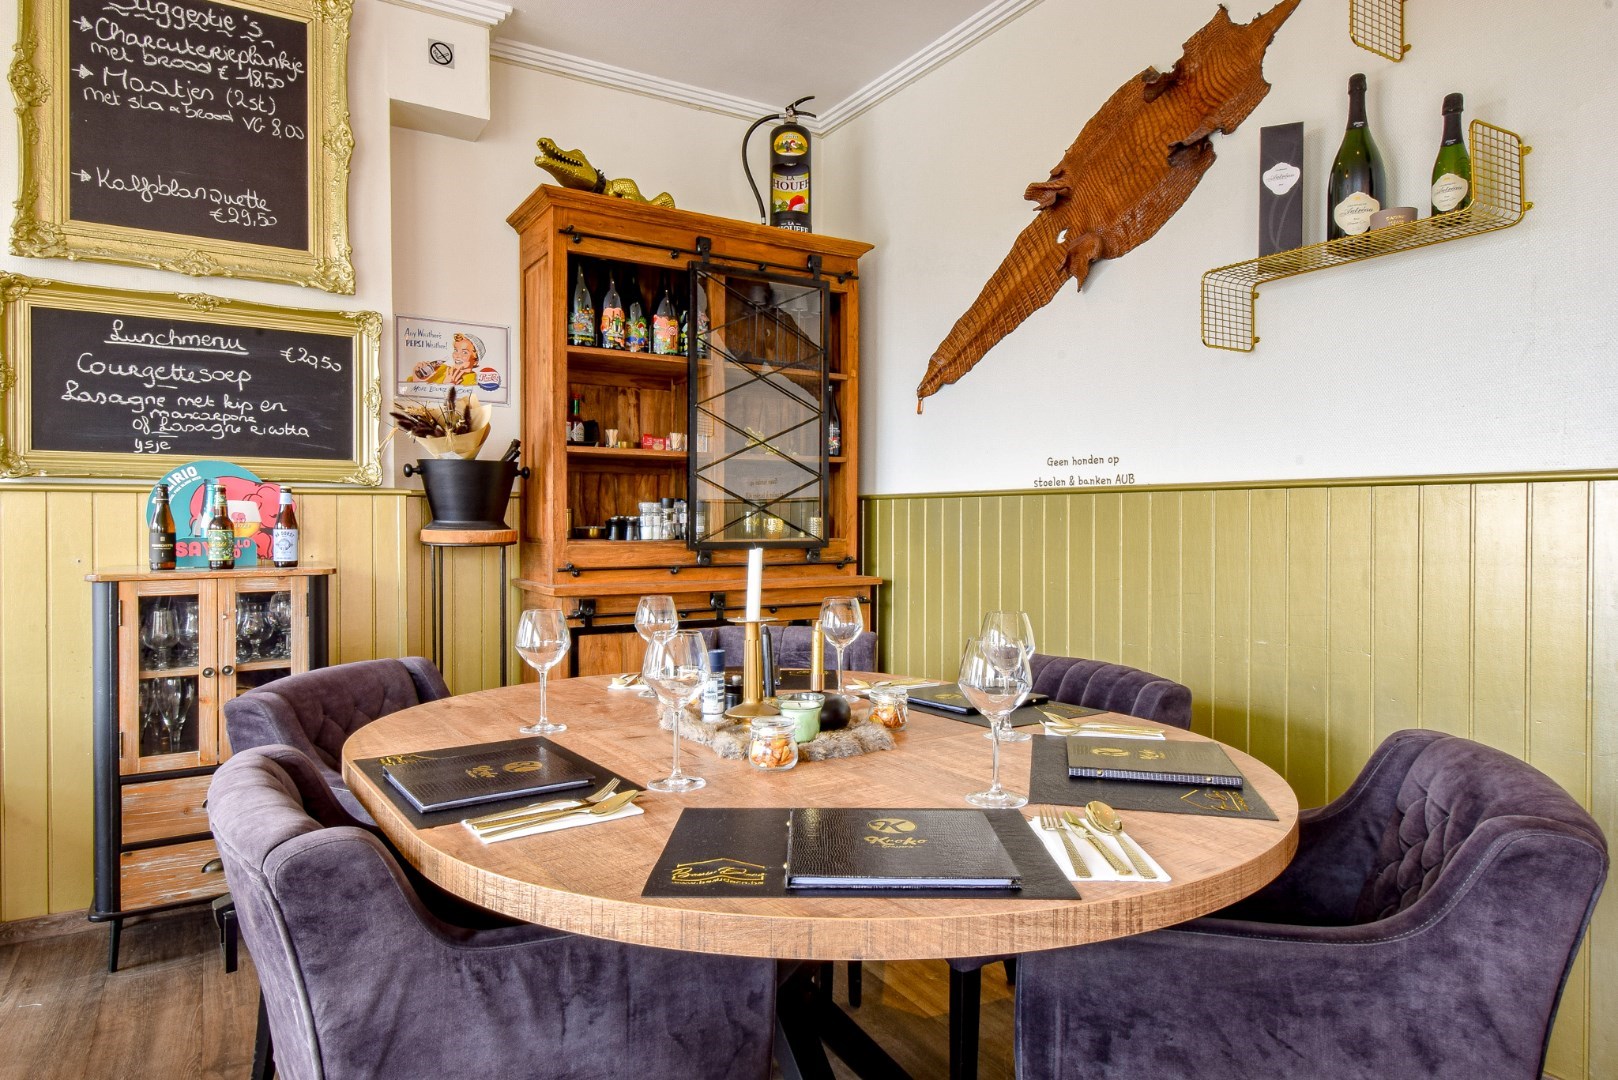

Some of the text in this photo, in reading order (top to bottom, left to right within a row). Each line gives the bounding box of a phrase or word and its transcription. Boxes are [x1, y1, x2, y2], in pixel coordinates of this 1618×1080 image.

[91, 42, 133, 62] met
[143, 46, 212, 73] brood
[103, 66, 276, 115] Maatjes (2st)
[83, 87, 121, 106] met
[128, 95, 164, 111] sla
[185, 105, 234, 122] brood
[109, 319, 248, 351] Lunchmenu
[404, 328, 416, 338] Any
[405, 339, 424, 348] PEPSI
[77, 352, 252, 392] Courgettesoep
[61, 380, 287, 413] Lasagne met kip en
[150, 408, 257, 424] mascarpone
[132, 418, 151, 435] of
[250, 424, 310, 438] ricotta
[1046, 455, 1120, 467] Geen honden op
[1033, 473, 1136, 488] stoelen & banken AUB
[864, 836, 928, 846] Kroko
